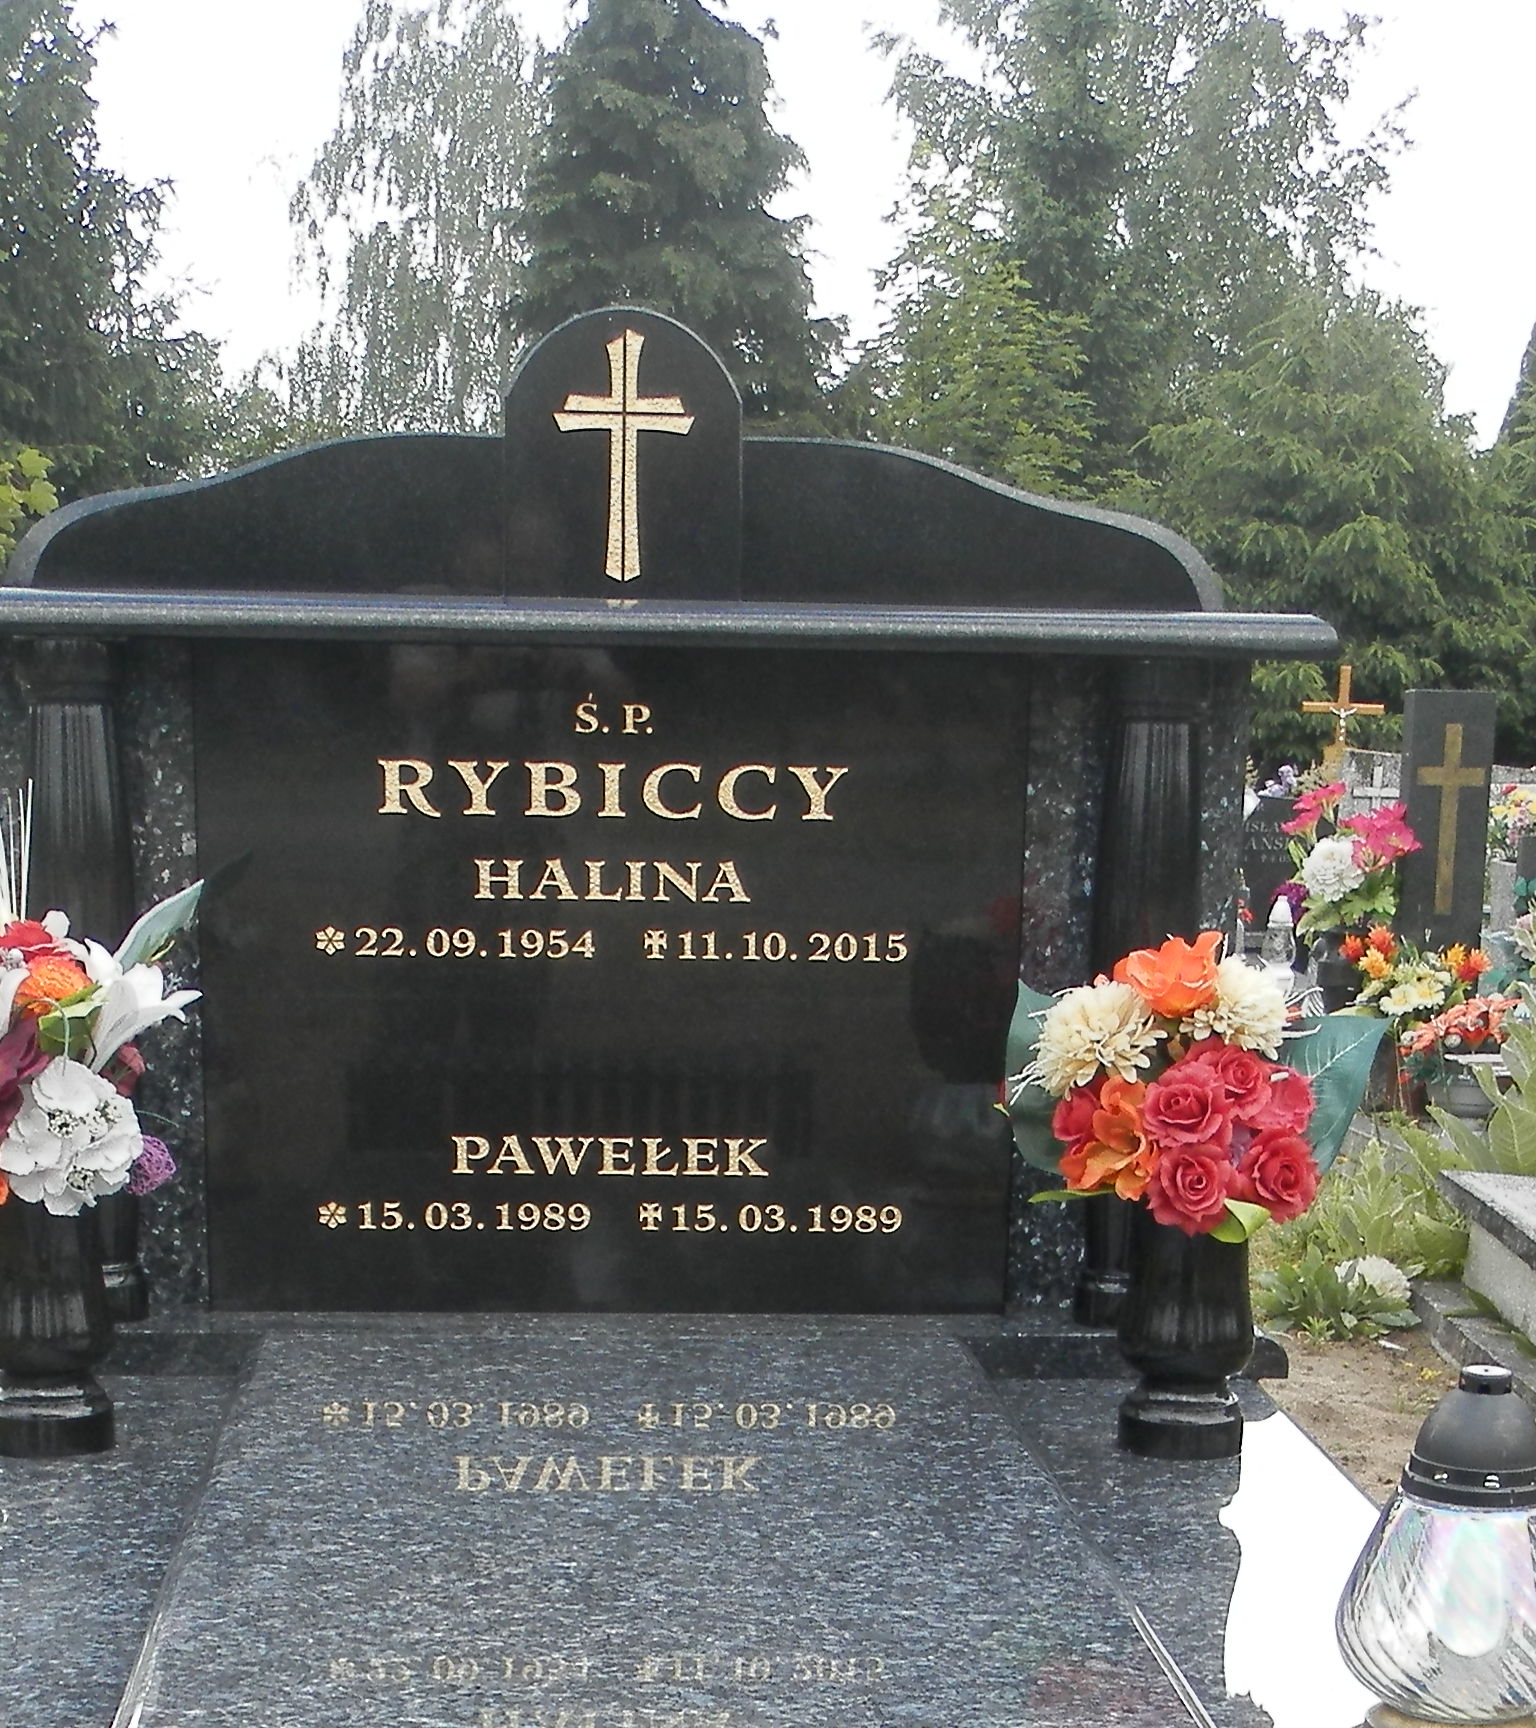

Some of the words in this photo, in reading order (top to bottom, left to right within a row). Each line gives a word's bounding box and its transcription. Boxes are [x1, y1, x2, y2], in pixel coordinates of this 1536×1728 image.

[574, 692, 611, 734] Ś.
[621, 703, 654, 735] P.
[376, 757, 850, 822] RYBICCY
[473, 857, 752, 902] HALINA
[450, 1134, 770, 1177] PAWEŁEK
